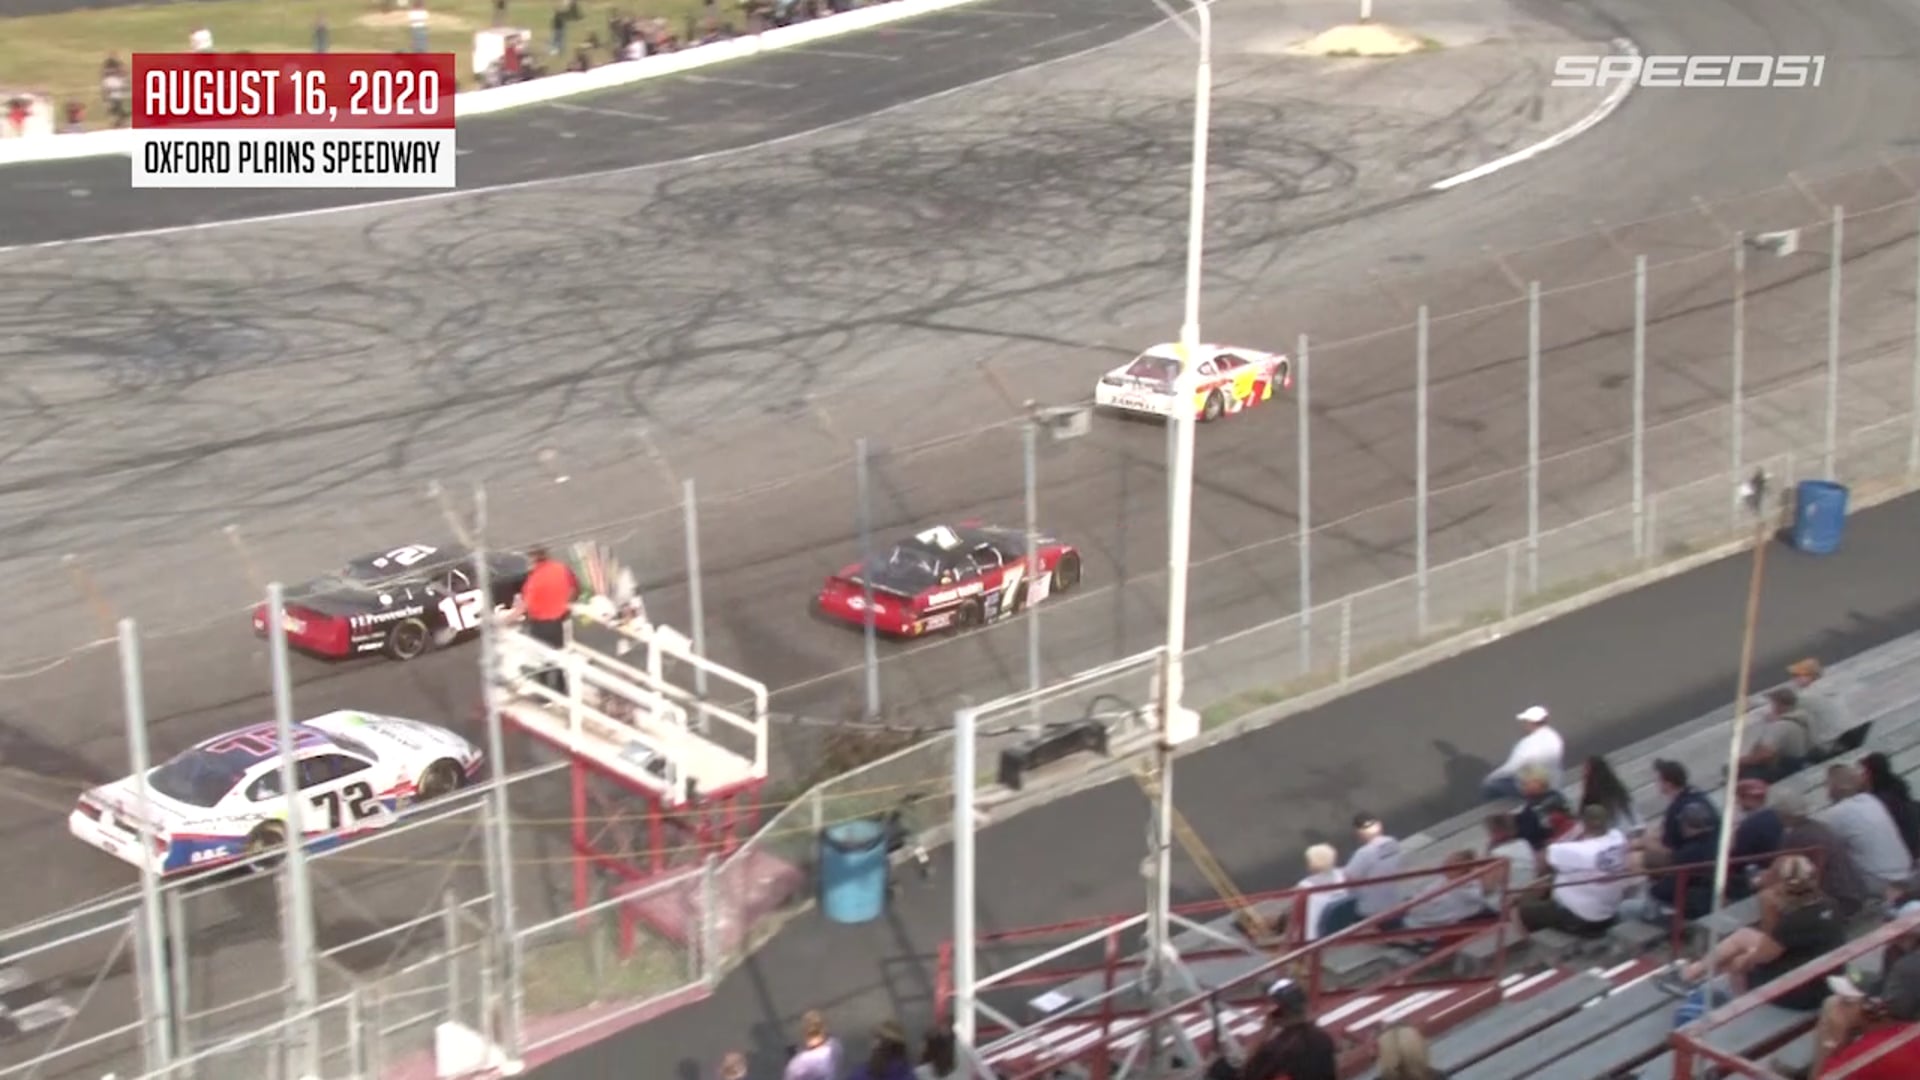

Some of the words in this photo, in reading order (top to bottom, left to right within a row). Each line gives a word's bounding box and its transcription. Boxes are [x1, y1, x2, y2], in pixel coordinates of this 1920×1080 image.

[438, 588, 483, 631] 12
[1001, 563, 1026, 612] 7
[310, 781, 381, 829] 72
